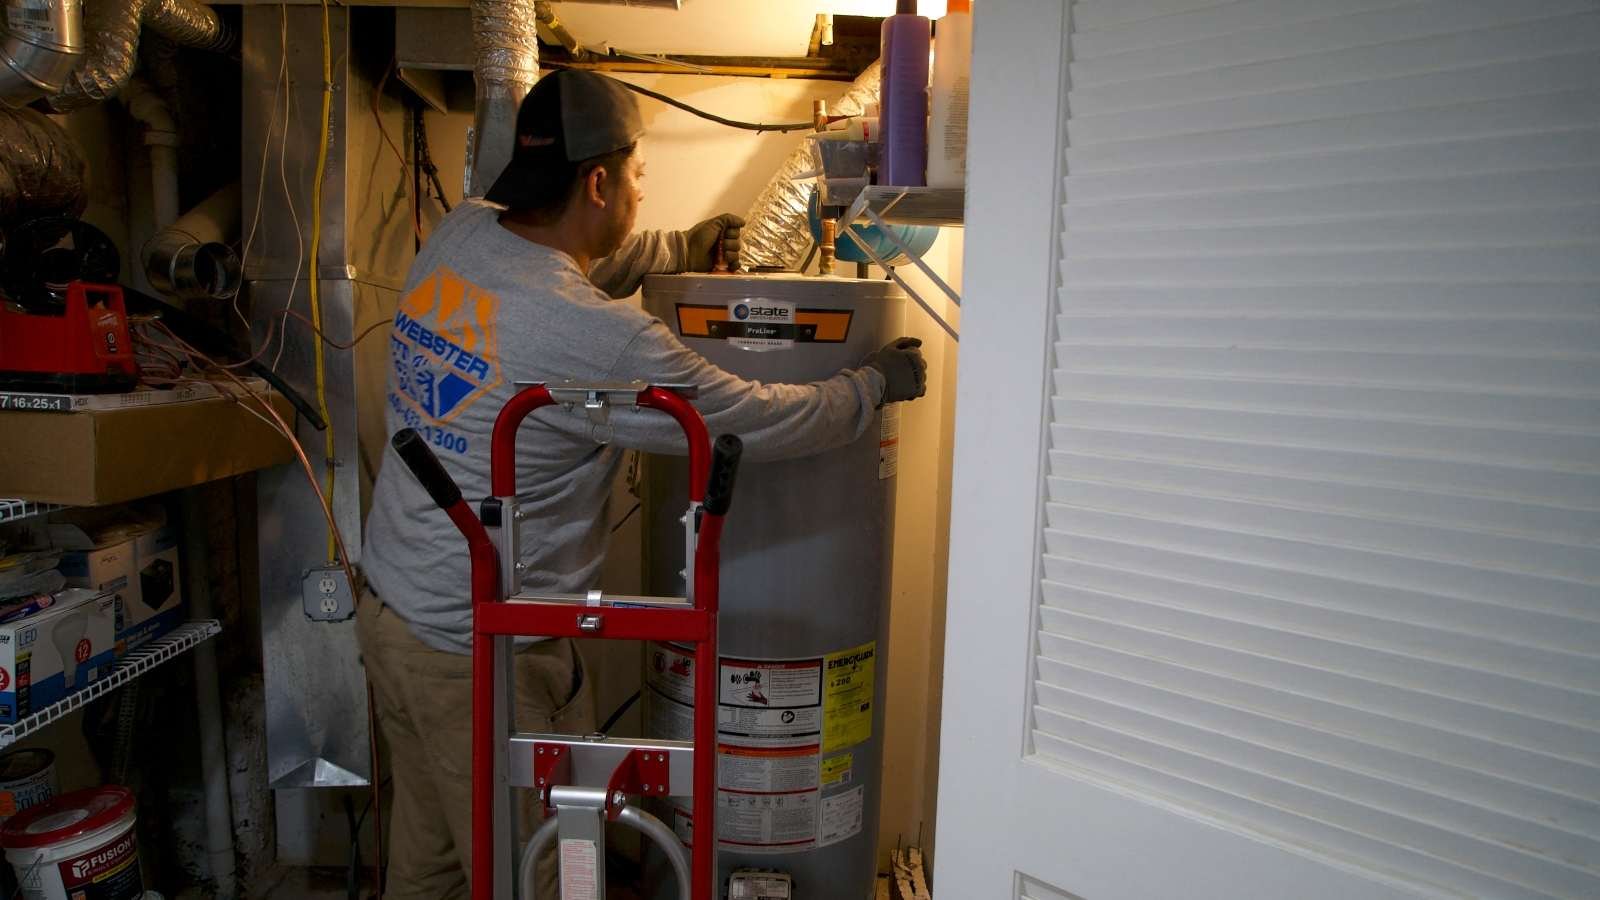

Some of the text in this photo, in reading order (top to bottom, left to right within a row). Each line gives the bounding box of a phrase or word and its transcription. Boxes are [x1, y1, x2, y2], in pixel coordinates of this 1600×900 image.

[750, 306, 789, 317] state
[394, 310, 490, 381] WEBSTER
[12, 396, 61, 409] 16x25x1
[19, 627, 38, 647] LED
[90, 837, 131, 869] FUSION
